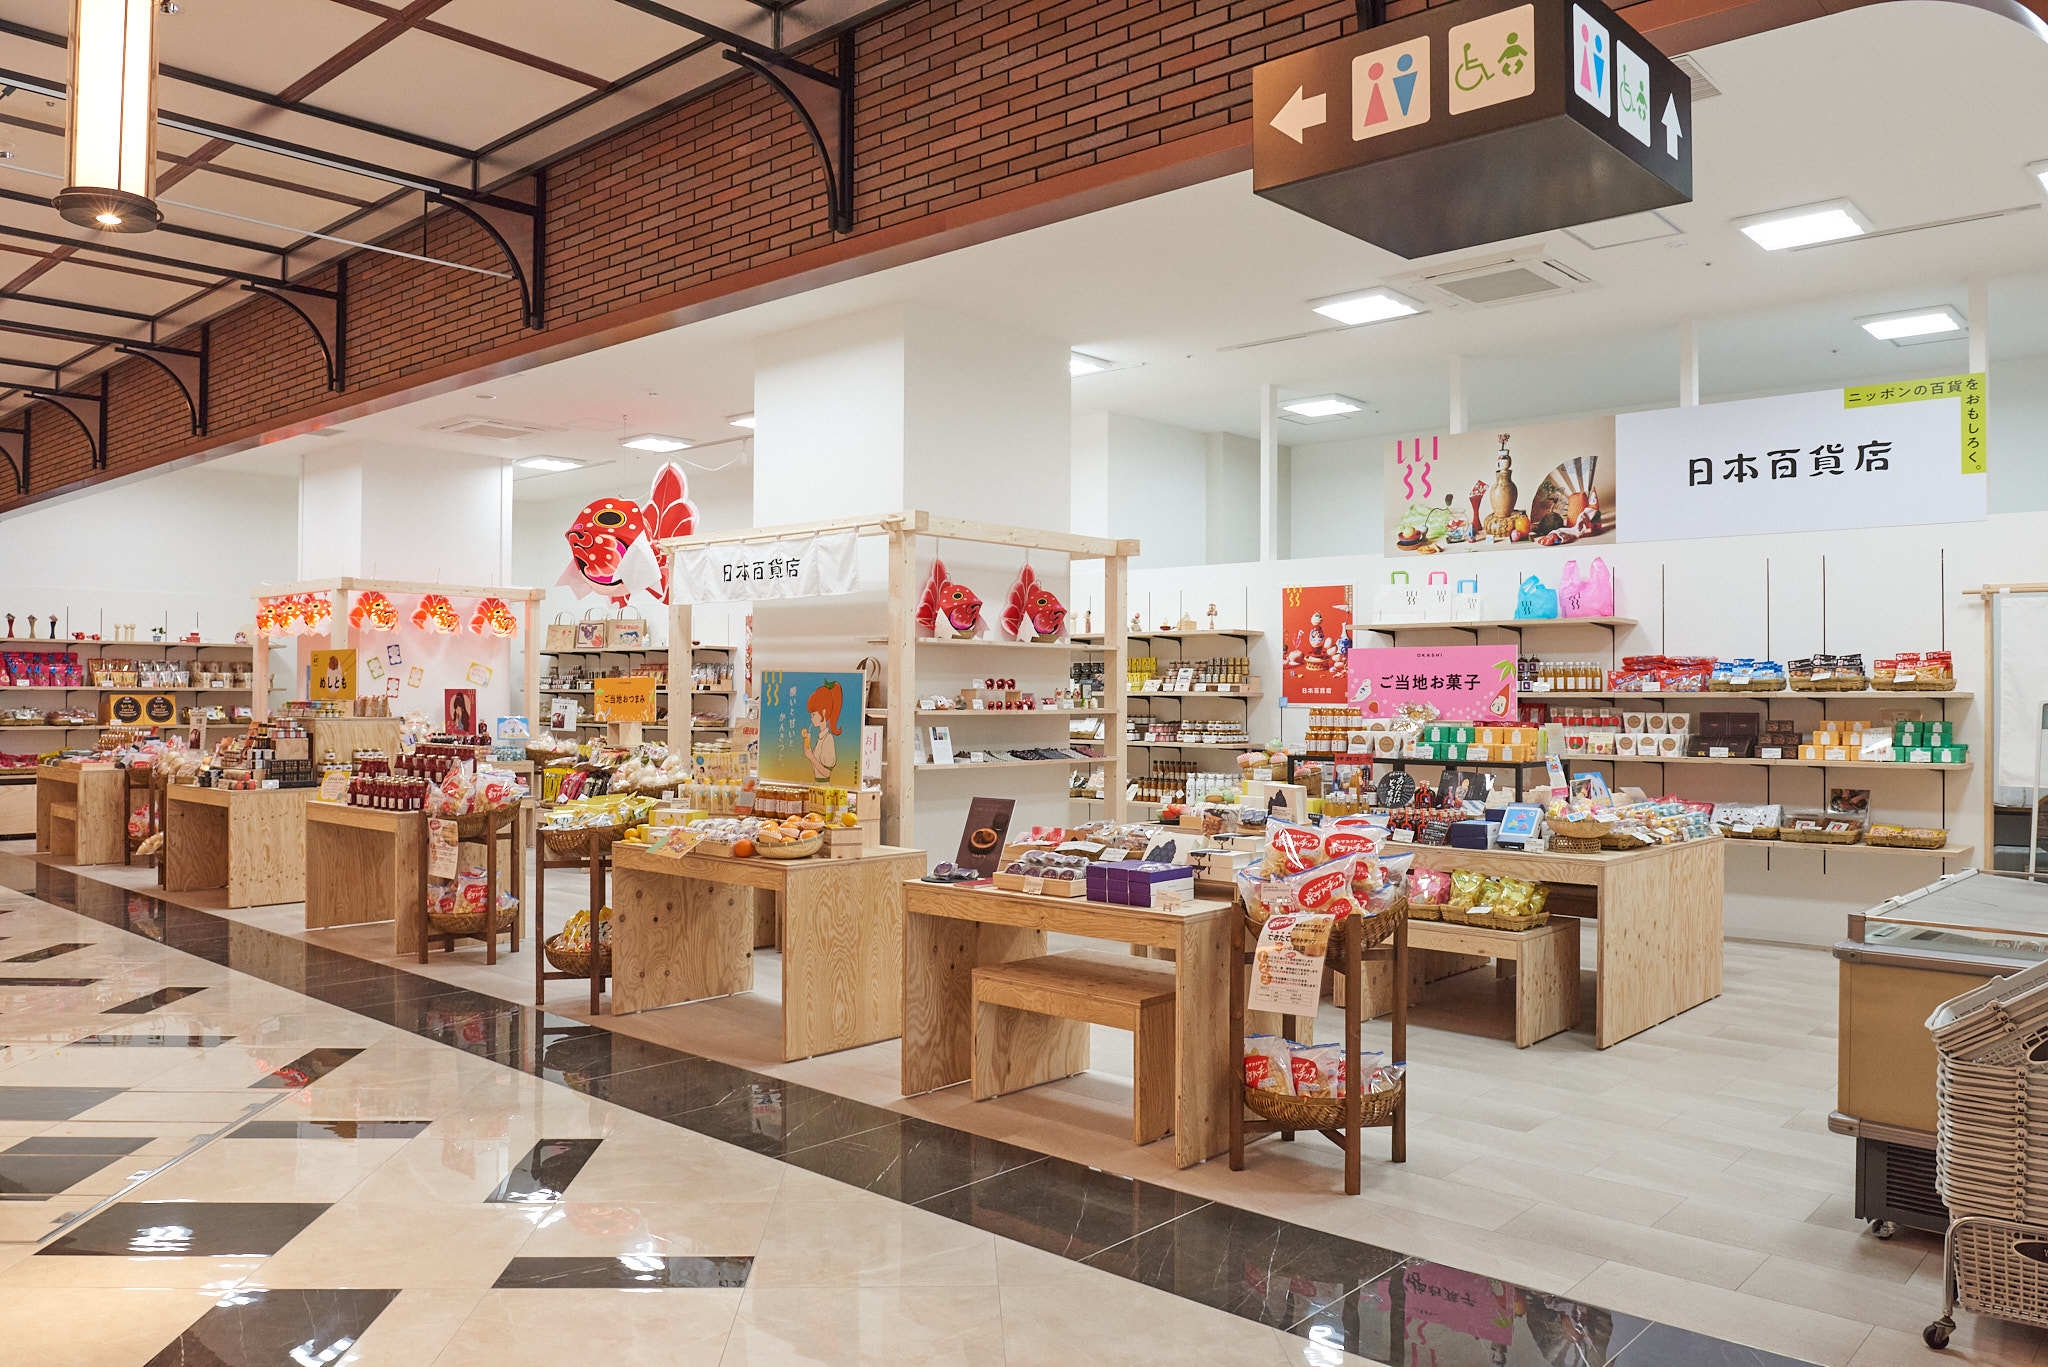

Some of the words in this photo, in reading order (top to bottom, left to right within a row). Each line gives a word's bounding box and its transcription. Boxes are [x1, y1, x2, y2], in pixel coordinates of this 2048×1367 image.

[1688, 439, 1893, 487] 日本百貨店
[723, 557, 801, 583] 日本百貨店
[319, 676, 347, 690] めしとも
[1380, 673, 1481, 691] ご当地お菓子
[604, 694, 645, 705] ご当地おつまみ
